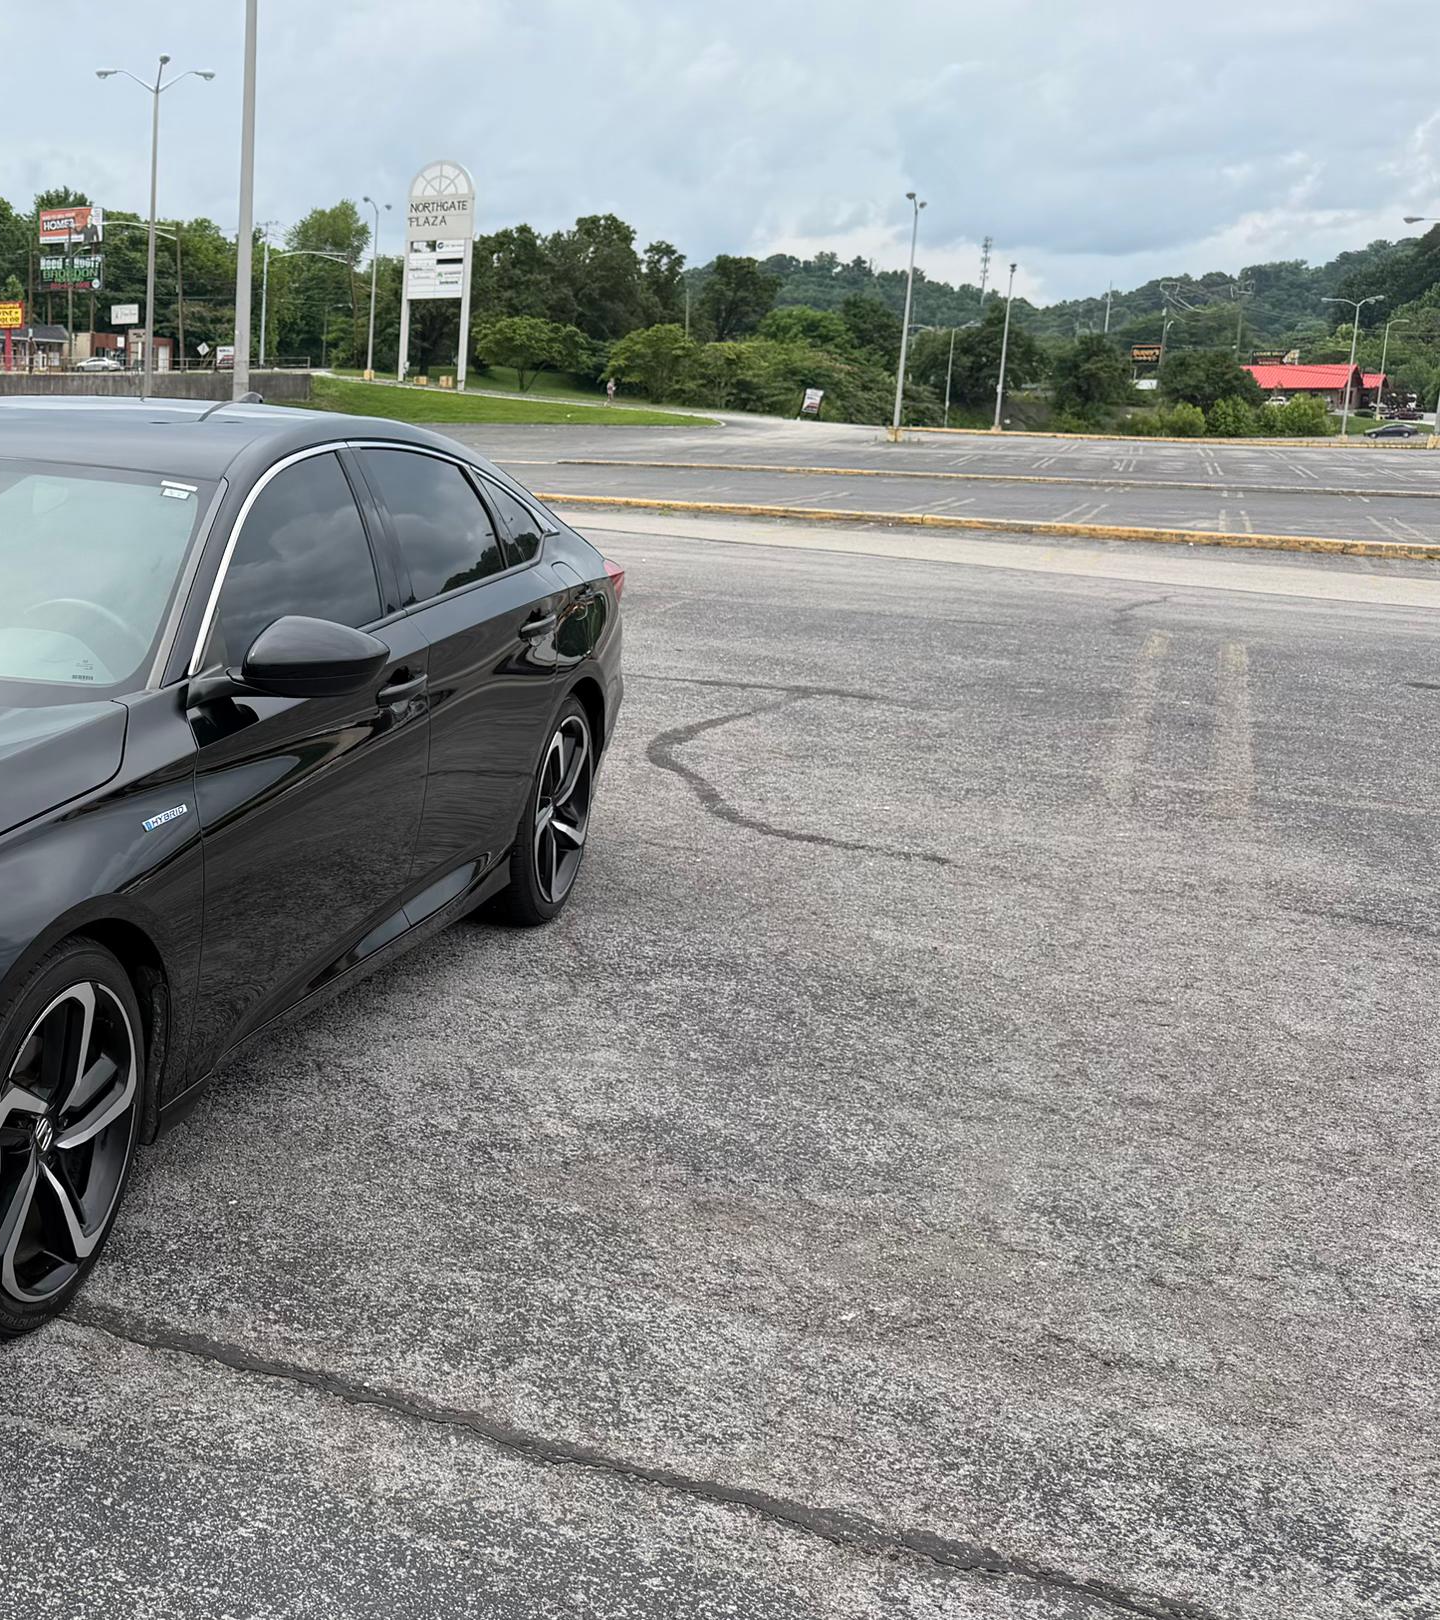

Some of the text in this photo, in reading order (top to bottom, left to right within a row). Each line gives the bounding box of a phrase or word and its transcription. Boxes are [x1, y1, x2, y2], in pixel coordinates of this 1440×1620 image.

[410, 200, 468, 214] NORTHGATE
[408, 215, 447, 227] PLAZA
[152, 806, 185, 827] HYBRID
